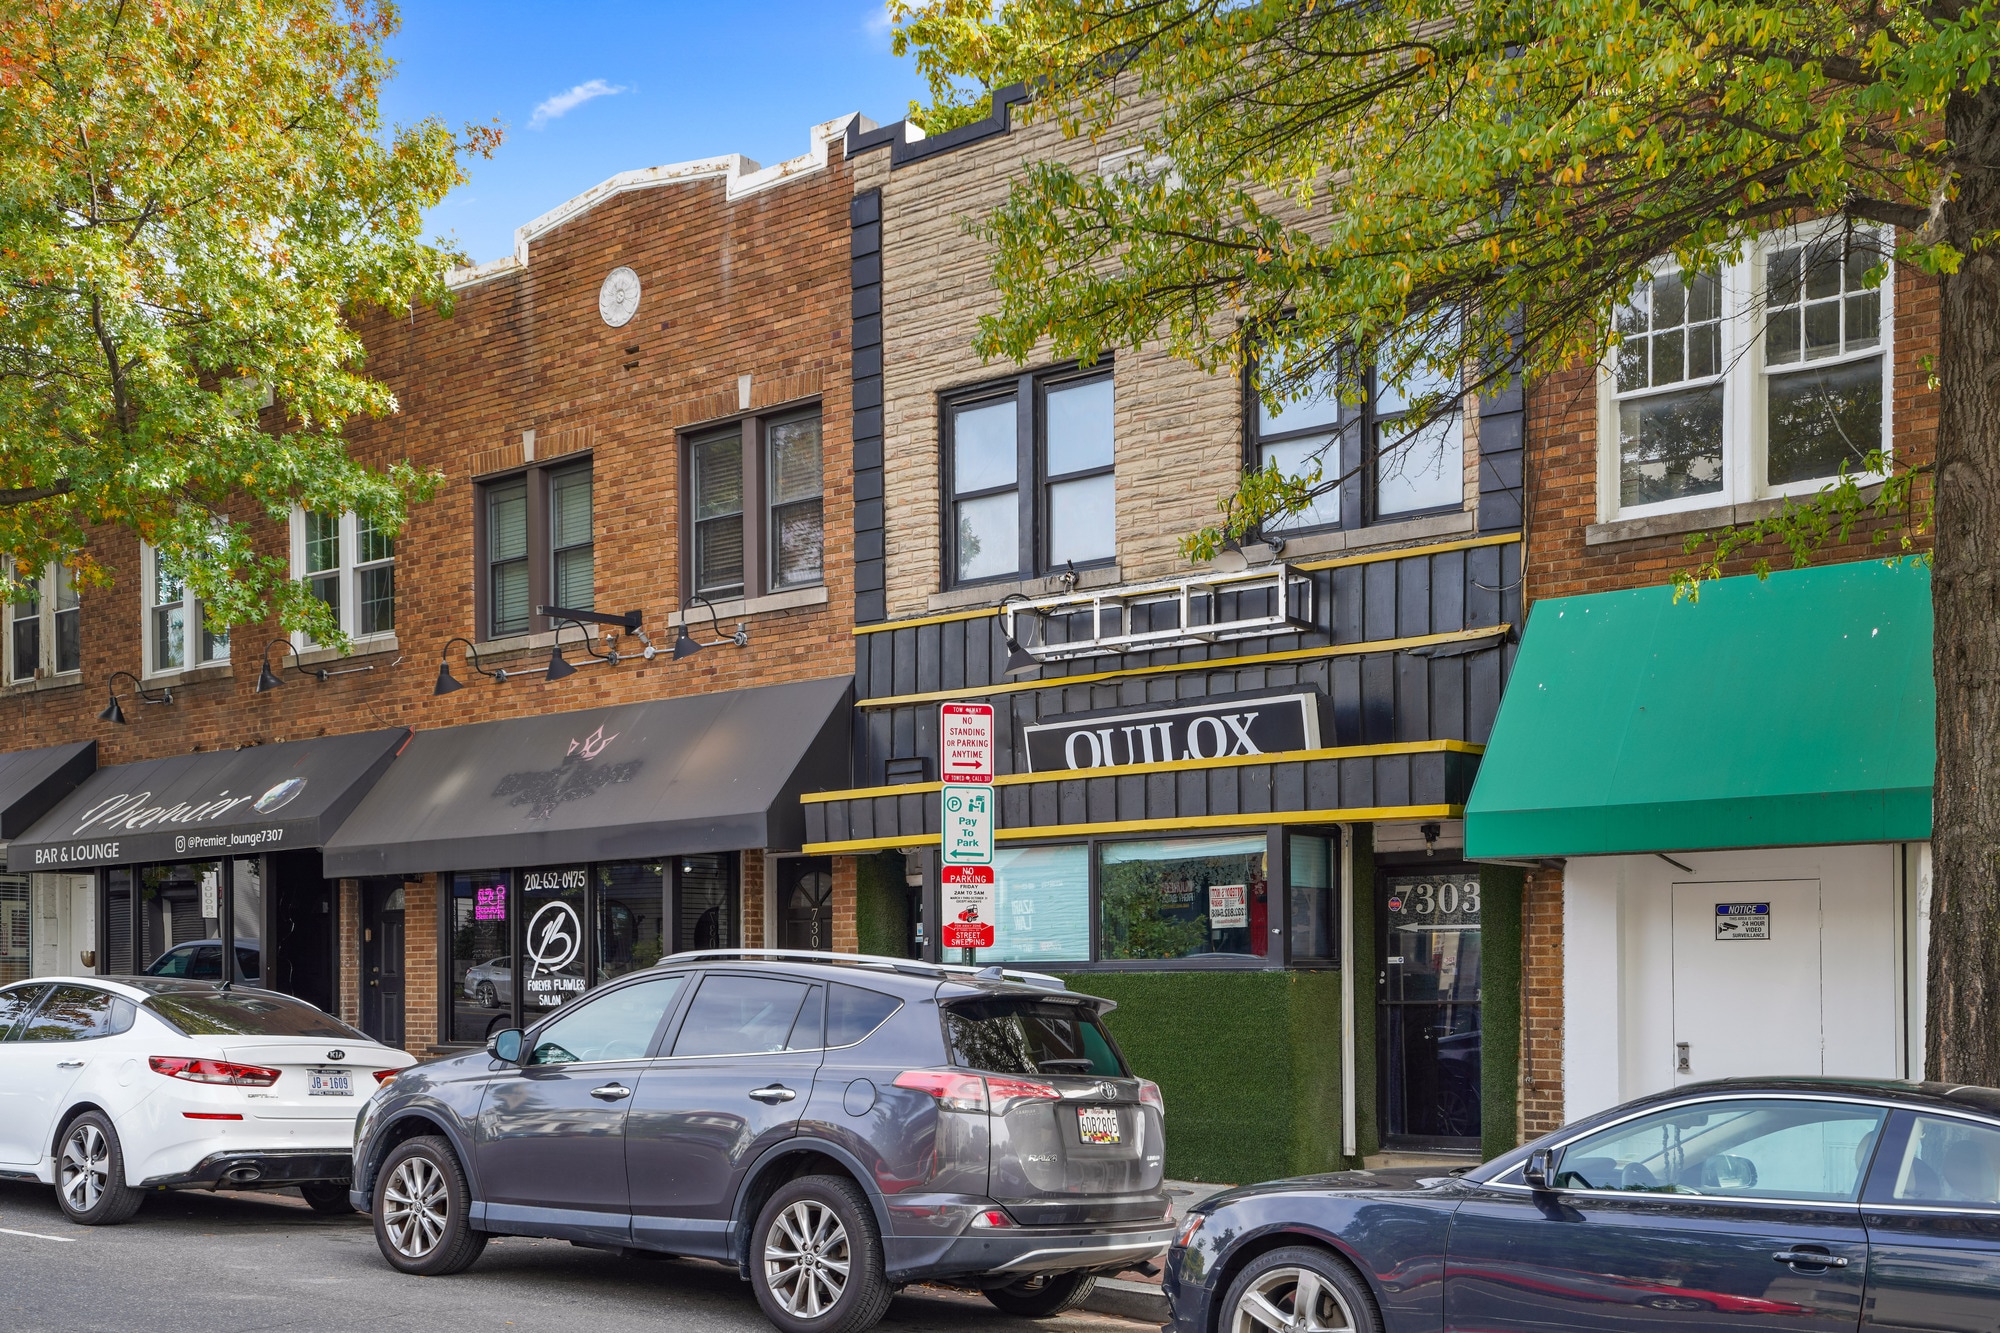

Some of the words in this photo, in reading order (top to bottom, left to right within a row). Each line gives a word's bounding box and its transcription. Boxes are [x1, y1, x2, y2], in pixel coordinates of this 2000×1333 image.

[950, 728, 986, 736] STANDING
[956, 739, 988, 747] PARKING
[72, 790, 252, 836] Premier
[958, 817, 977, 827] Pay
[188, 829, 284, 848] @Premier_lounge7307
[957, 838, 979, 846] Park
[36, 847, 58, 864] BAR
[60, 848, 68, 862] &
[71, 842, 120, 861] LOUNGE
[524, 870, 586, 892] 202-652-0475
[951, 875, 987, 884] PARKING
[1395, 882, 1480, 914] 7303
[1728, 906, 1757, 914] NOTICE
[528, 980, 551, 992] FOREVER
[553, 979, 586, 991] FLAWLES
[539, 994, 561, 1006] SALON
[312, 1077, 321, 1088] JB
[329, 1077, 348, 1089] 1609
[1081, 1117, 1118, 1134] 6DB2805
[1028, 1154, 1057, 1162] RAV4
